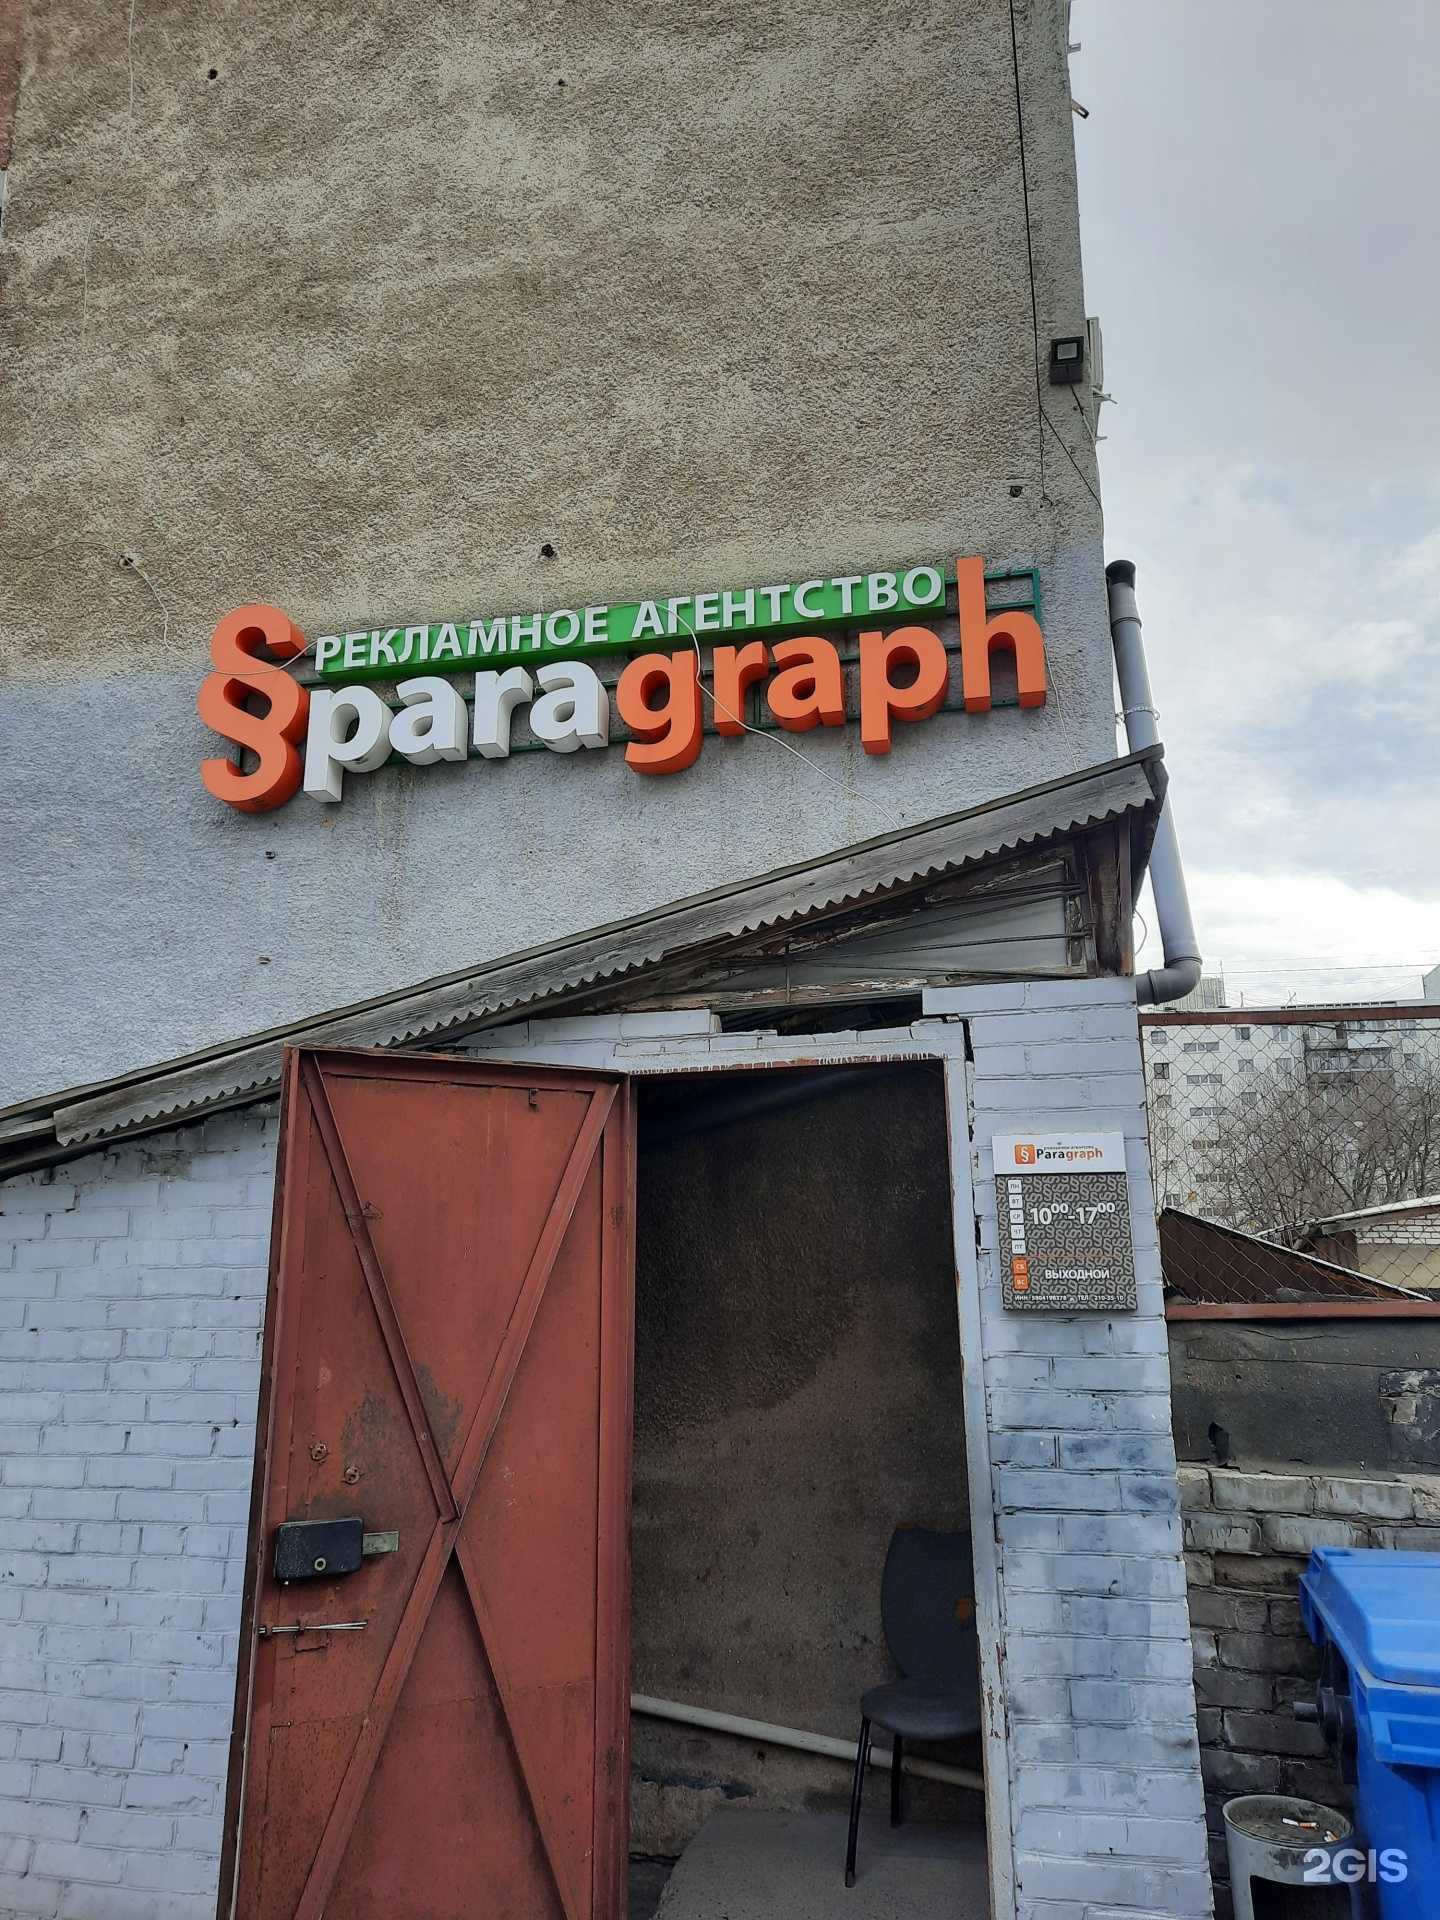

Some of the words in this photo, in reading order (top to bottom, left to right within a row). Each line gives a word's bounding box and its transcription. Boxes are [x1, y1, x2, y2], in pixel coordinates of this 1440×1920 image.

[314, 605, 609, 671] РЕКЛАМНОЕ
[631, 566, 942, 638] АГЕНТСТВО
[1036, 1147, 1103, 1162] Paragraph
[1045, 1268, 1110, 1281] ВЫХОДНОЙ
